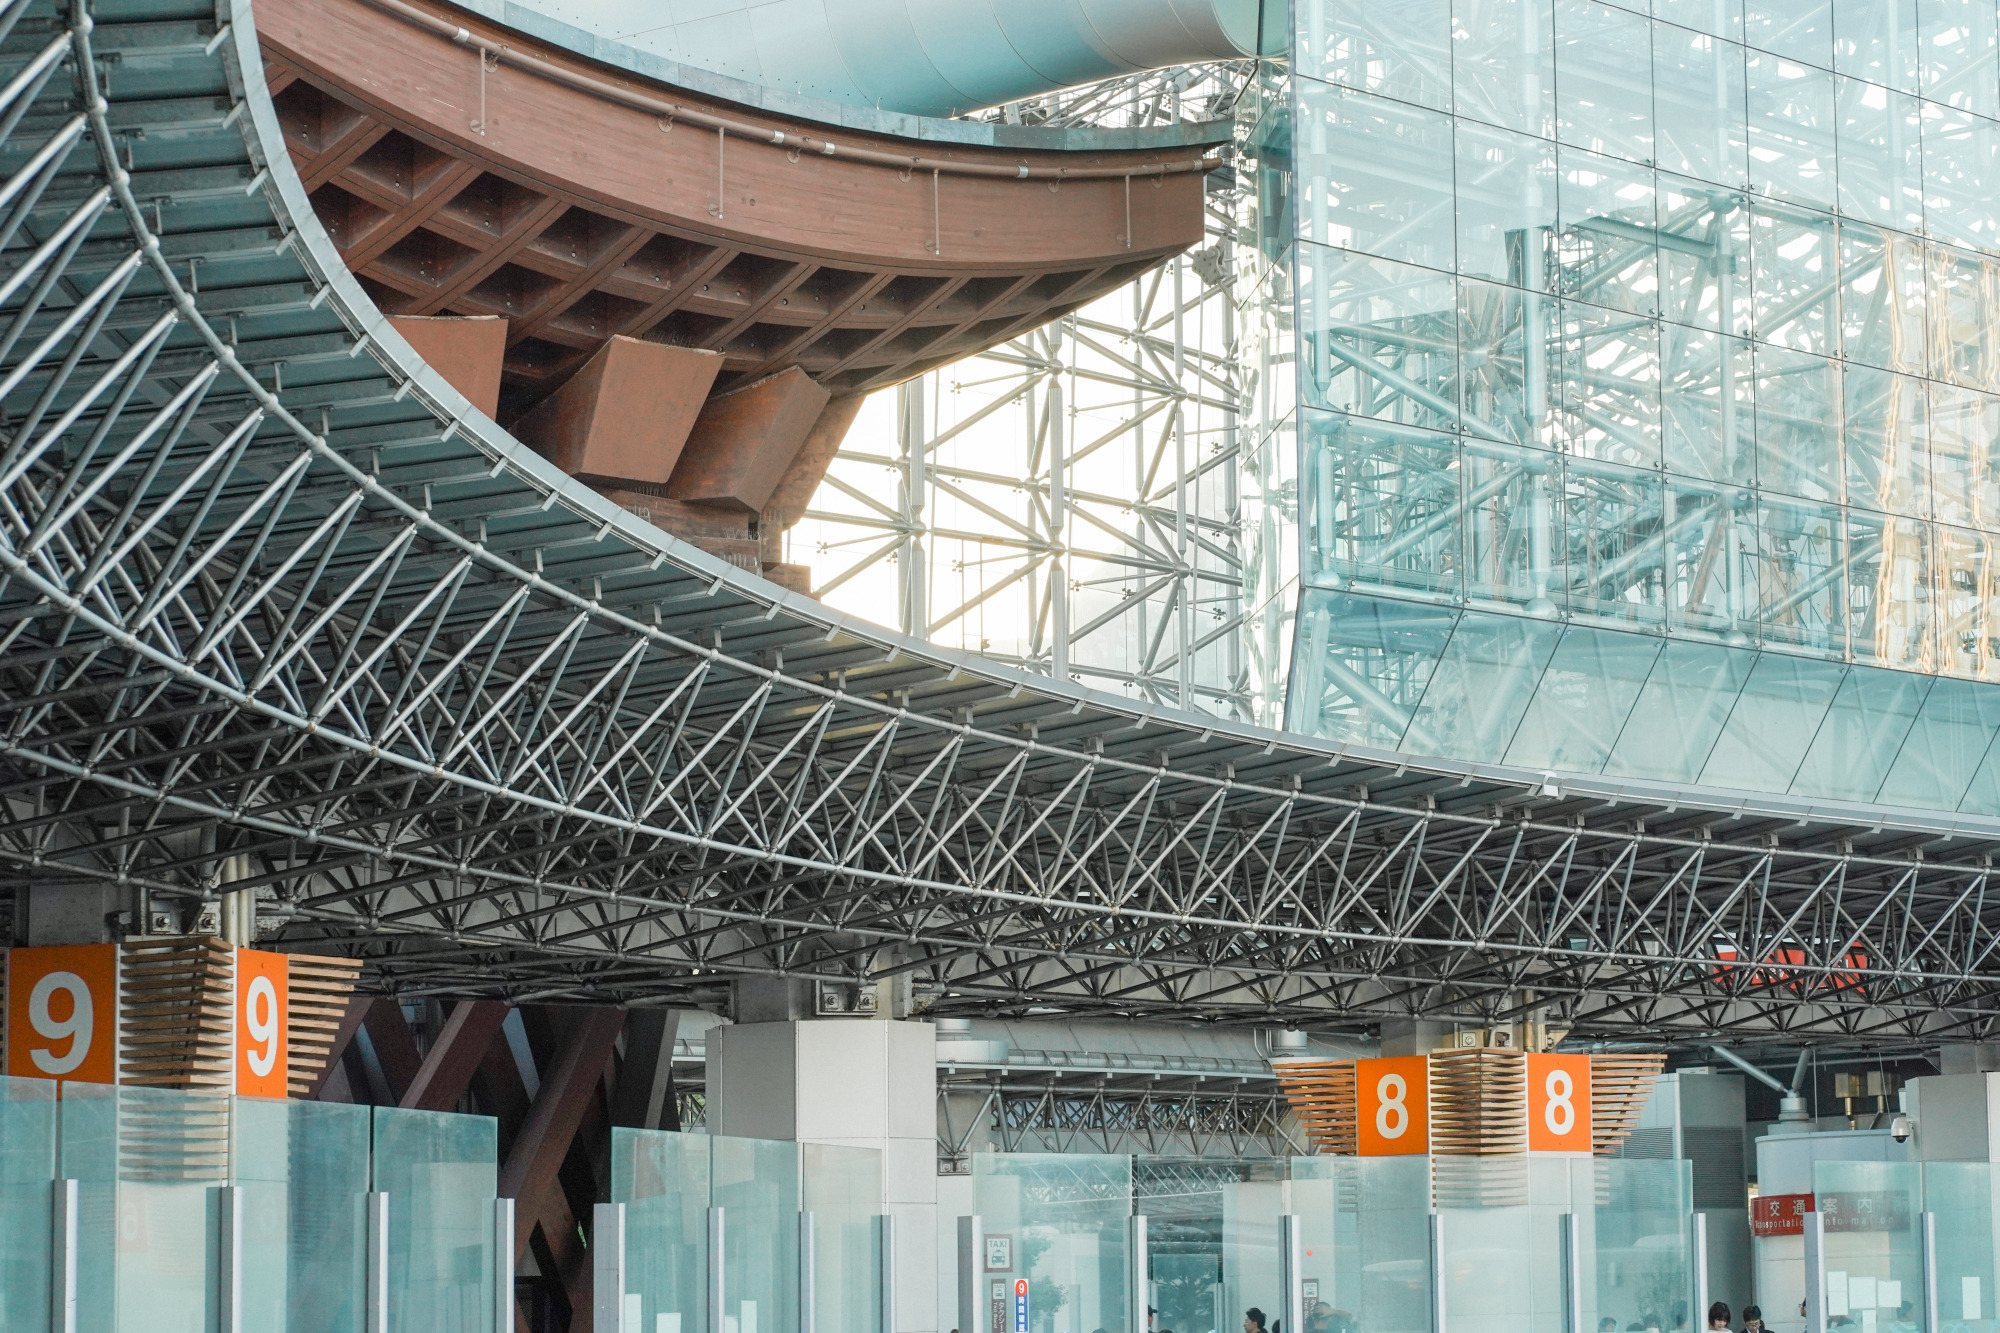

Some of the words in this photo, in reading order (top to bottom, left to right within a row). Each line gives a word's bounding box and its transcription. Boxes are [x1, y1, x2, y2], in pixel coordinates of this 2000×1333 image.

[28, 971, 94, 1075] 9
[246, 976, 278, 1077] 9
[1376, 1073, 1409, 1139] 8
[1545, 1069, 1575, 1136] 8
[989, 1240, 1007, 1248] TAXI
[1755, 1217, 1804, 1229] Transportatio
[1825, 1216, 1893, 1226] nfomaon
[1019, 1283, 1025, 1293] 9
